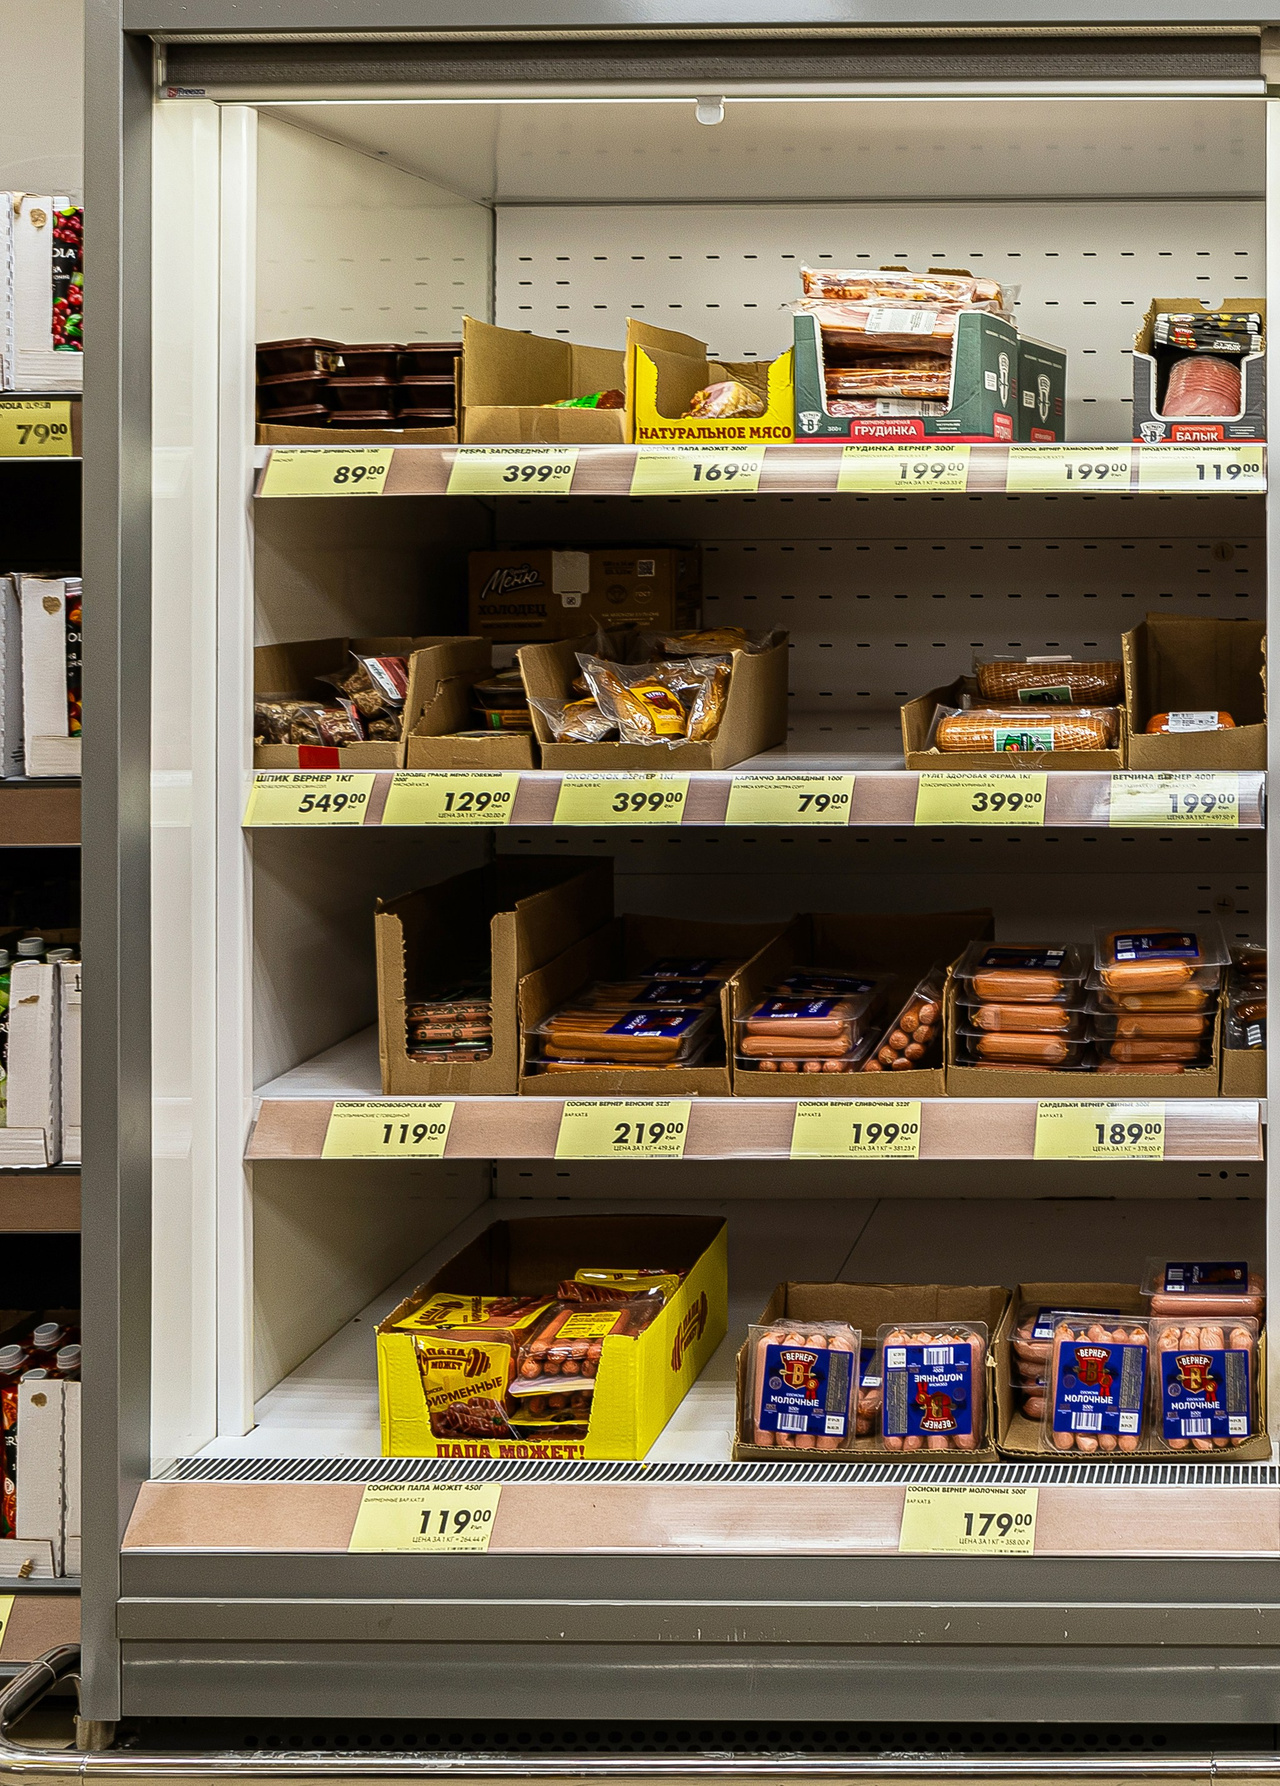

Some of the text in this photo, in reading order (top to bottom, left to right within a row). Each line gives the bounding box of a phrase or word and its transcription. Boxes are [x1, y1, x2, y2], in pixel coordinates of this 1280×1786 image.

[639, 426, 792, 439] НАТУРАЛЬНОЕ МЯСО
[854, 425, 917, 437] ГРУДИНКА
[1176, 432, 1219, 441] БАЛЫК
[478, 603, 548, 615] ХОЛОДЕЦ
[256, 774, 354, 782] ШПИК ВЕРНЕР 1КГ
[683, 1299, 699, 1331] ПАПА
[426, 1348, 466, 1357] ПАПА
[785, 1352, 813, 1363] ВЕРНЕР
[1079, 1348, 1108, 1359] ВЕРНЕР
[431, 1361, 463, 1370] МОЖЕТ
[1180, 1356, 1208, 1366] ВЕРНЕР
[914, 1373, 963, 1383] МОЛОЧНЫЕ
[770, 1395, 819, 1407] МОЛОЧНЫЕ
[1064, 1394, 1113, 1404] МОЛОЧНЫЕ
[1171, 1400, 1220, 1410] МОЛОЧНЫЕ
[924, 1420, 952, 1429] ВЕРНЕР
[436, 1444, 586, 1460] ПАПА МОЖЕТ!
